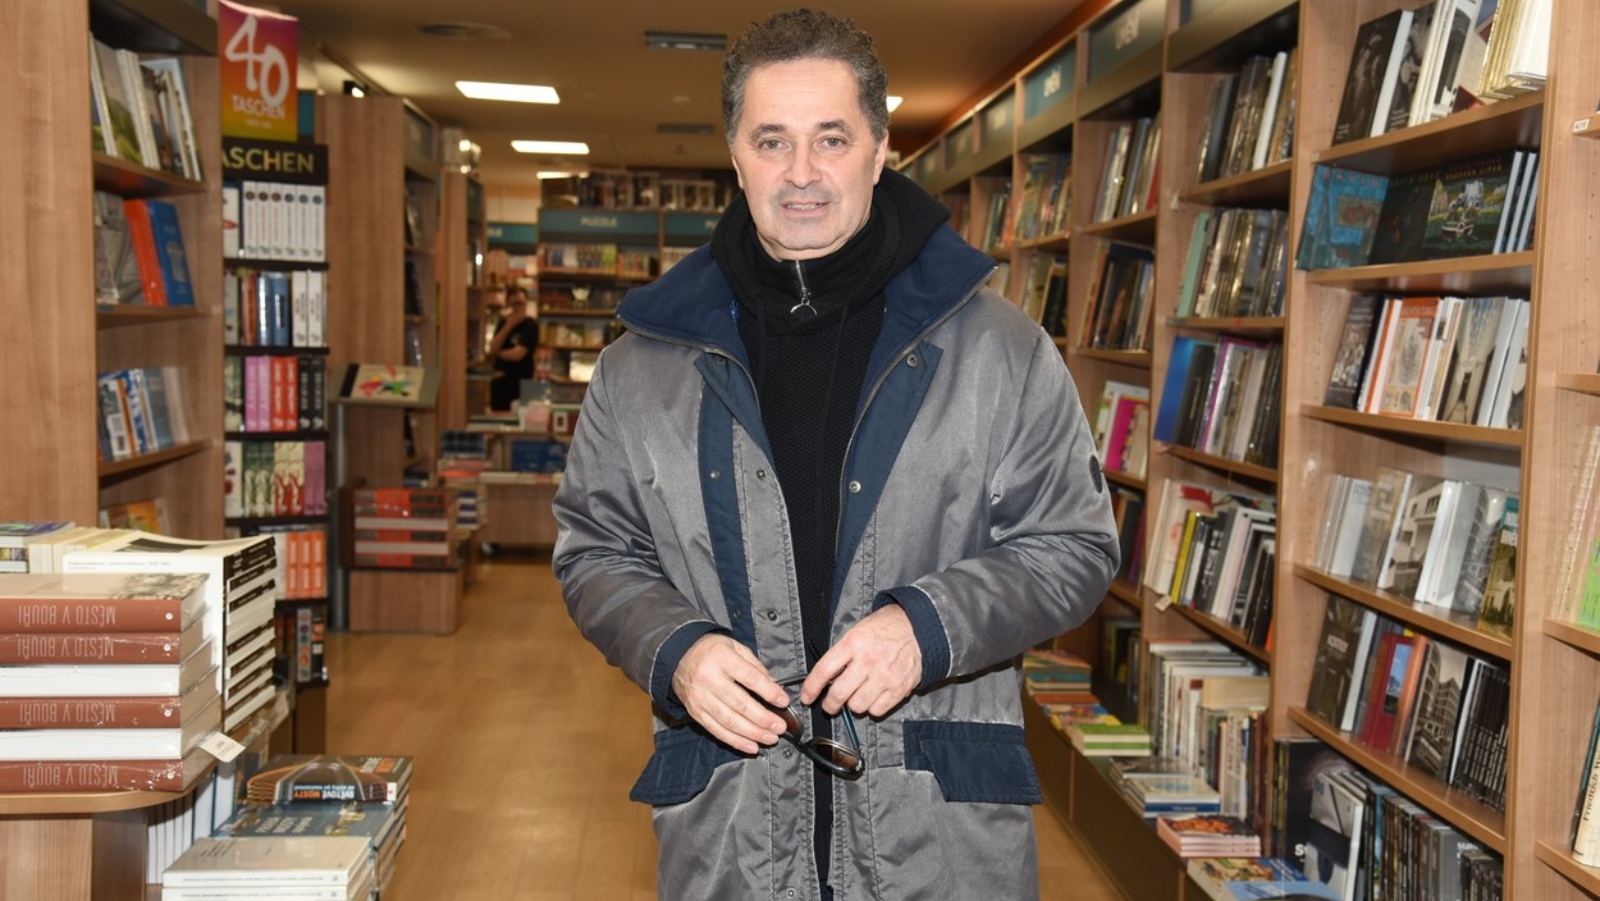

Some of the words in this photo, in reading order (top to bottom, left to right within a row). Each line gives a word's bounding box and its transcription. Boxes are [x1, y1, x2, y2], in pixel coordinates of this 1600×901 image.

[225, 14, 289, 107] 40
[230, 94, 286, 120] TASCHEN
[580, 216, 618, 228] PUZZLE
[18, 604, 57, 628] BOUŘI
[62, 604, 71, 625] V
[76, 604, 116, 627] MĚSTO
[18, 637, 56, 660] BOUŘI
[61, 637, 69, 657] V
[74, 637, 114, 660] MĚSTO
[19, 703, 57, 726] BOUŘI
[63, 703, 71, 723] V
[76, 703, 115, 726] MĚSTO
[23, 766, 61, 789] BOUŘI
[65, 766, 74, 786] V
[78, 767, 119, 789] MĚSTO
[293, 790, 321, 799] MOSTY
[322, 790, 355, 800] SVĚTOVÉ
[1583, 774, 1598, 822] Friedrich
